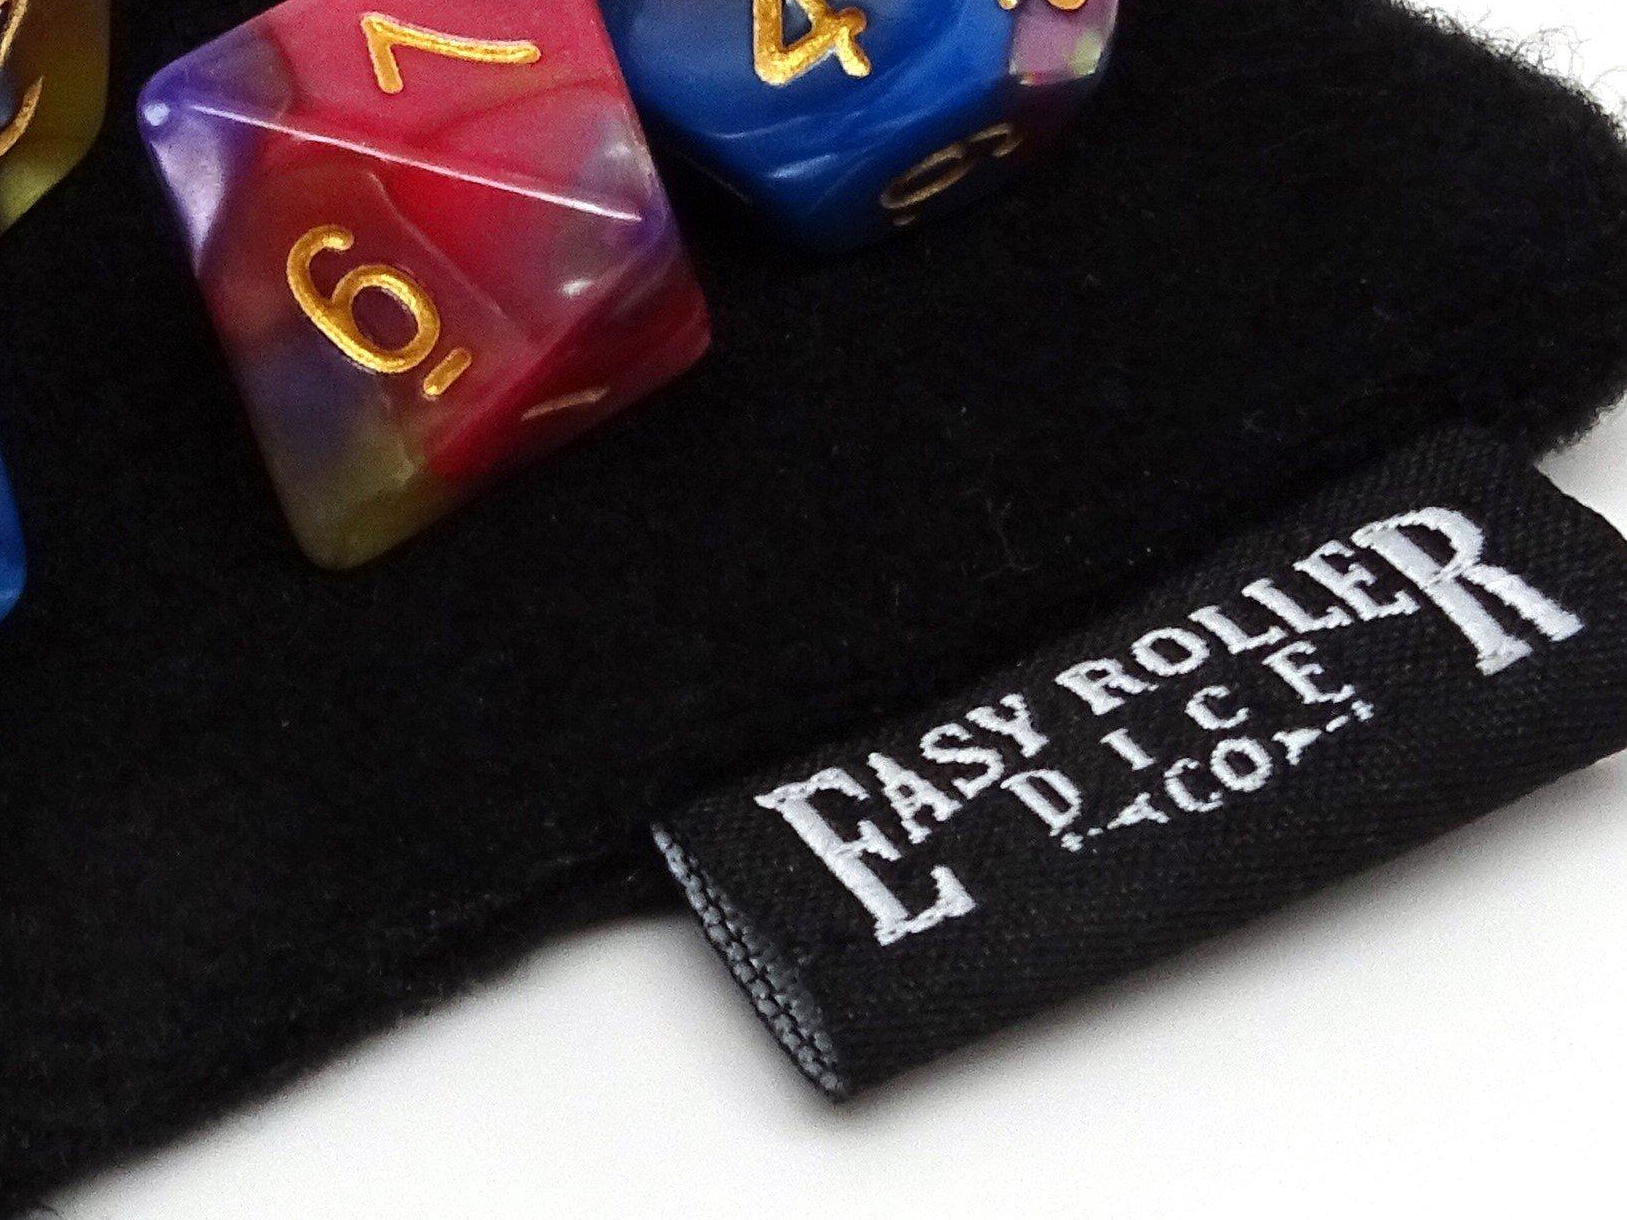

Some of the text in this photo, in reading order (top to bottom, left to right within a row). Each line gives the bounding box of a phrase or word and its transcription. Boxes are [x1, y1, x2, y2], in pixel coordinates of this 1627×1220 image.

[360, 9, 542, 94] 7
[753, 504, 1585, 946] EASY ROLLER
[1001, 639, 1355, 838] DICE
